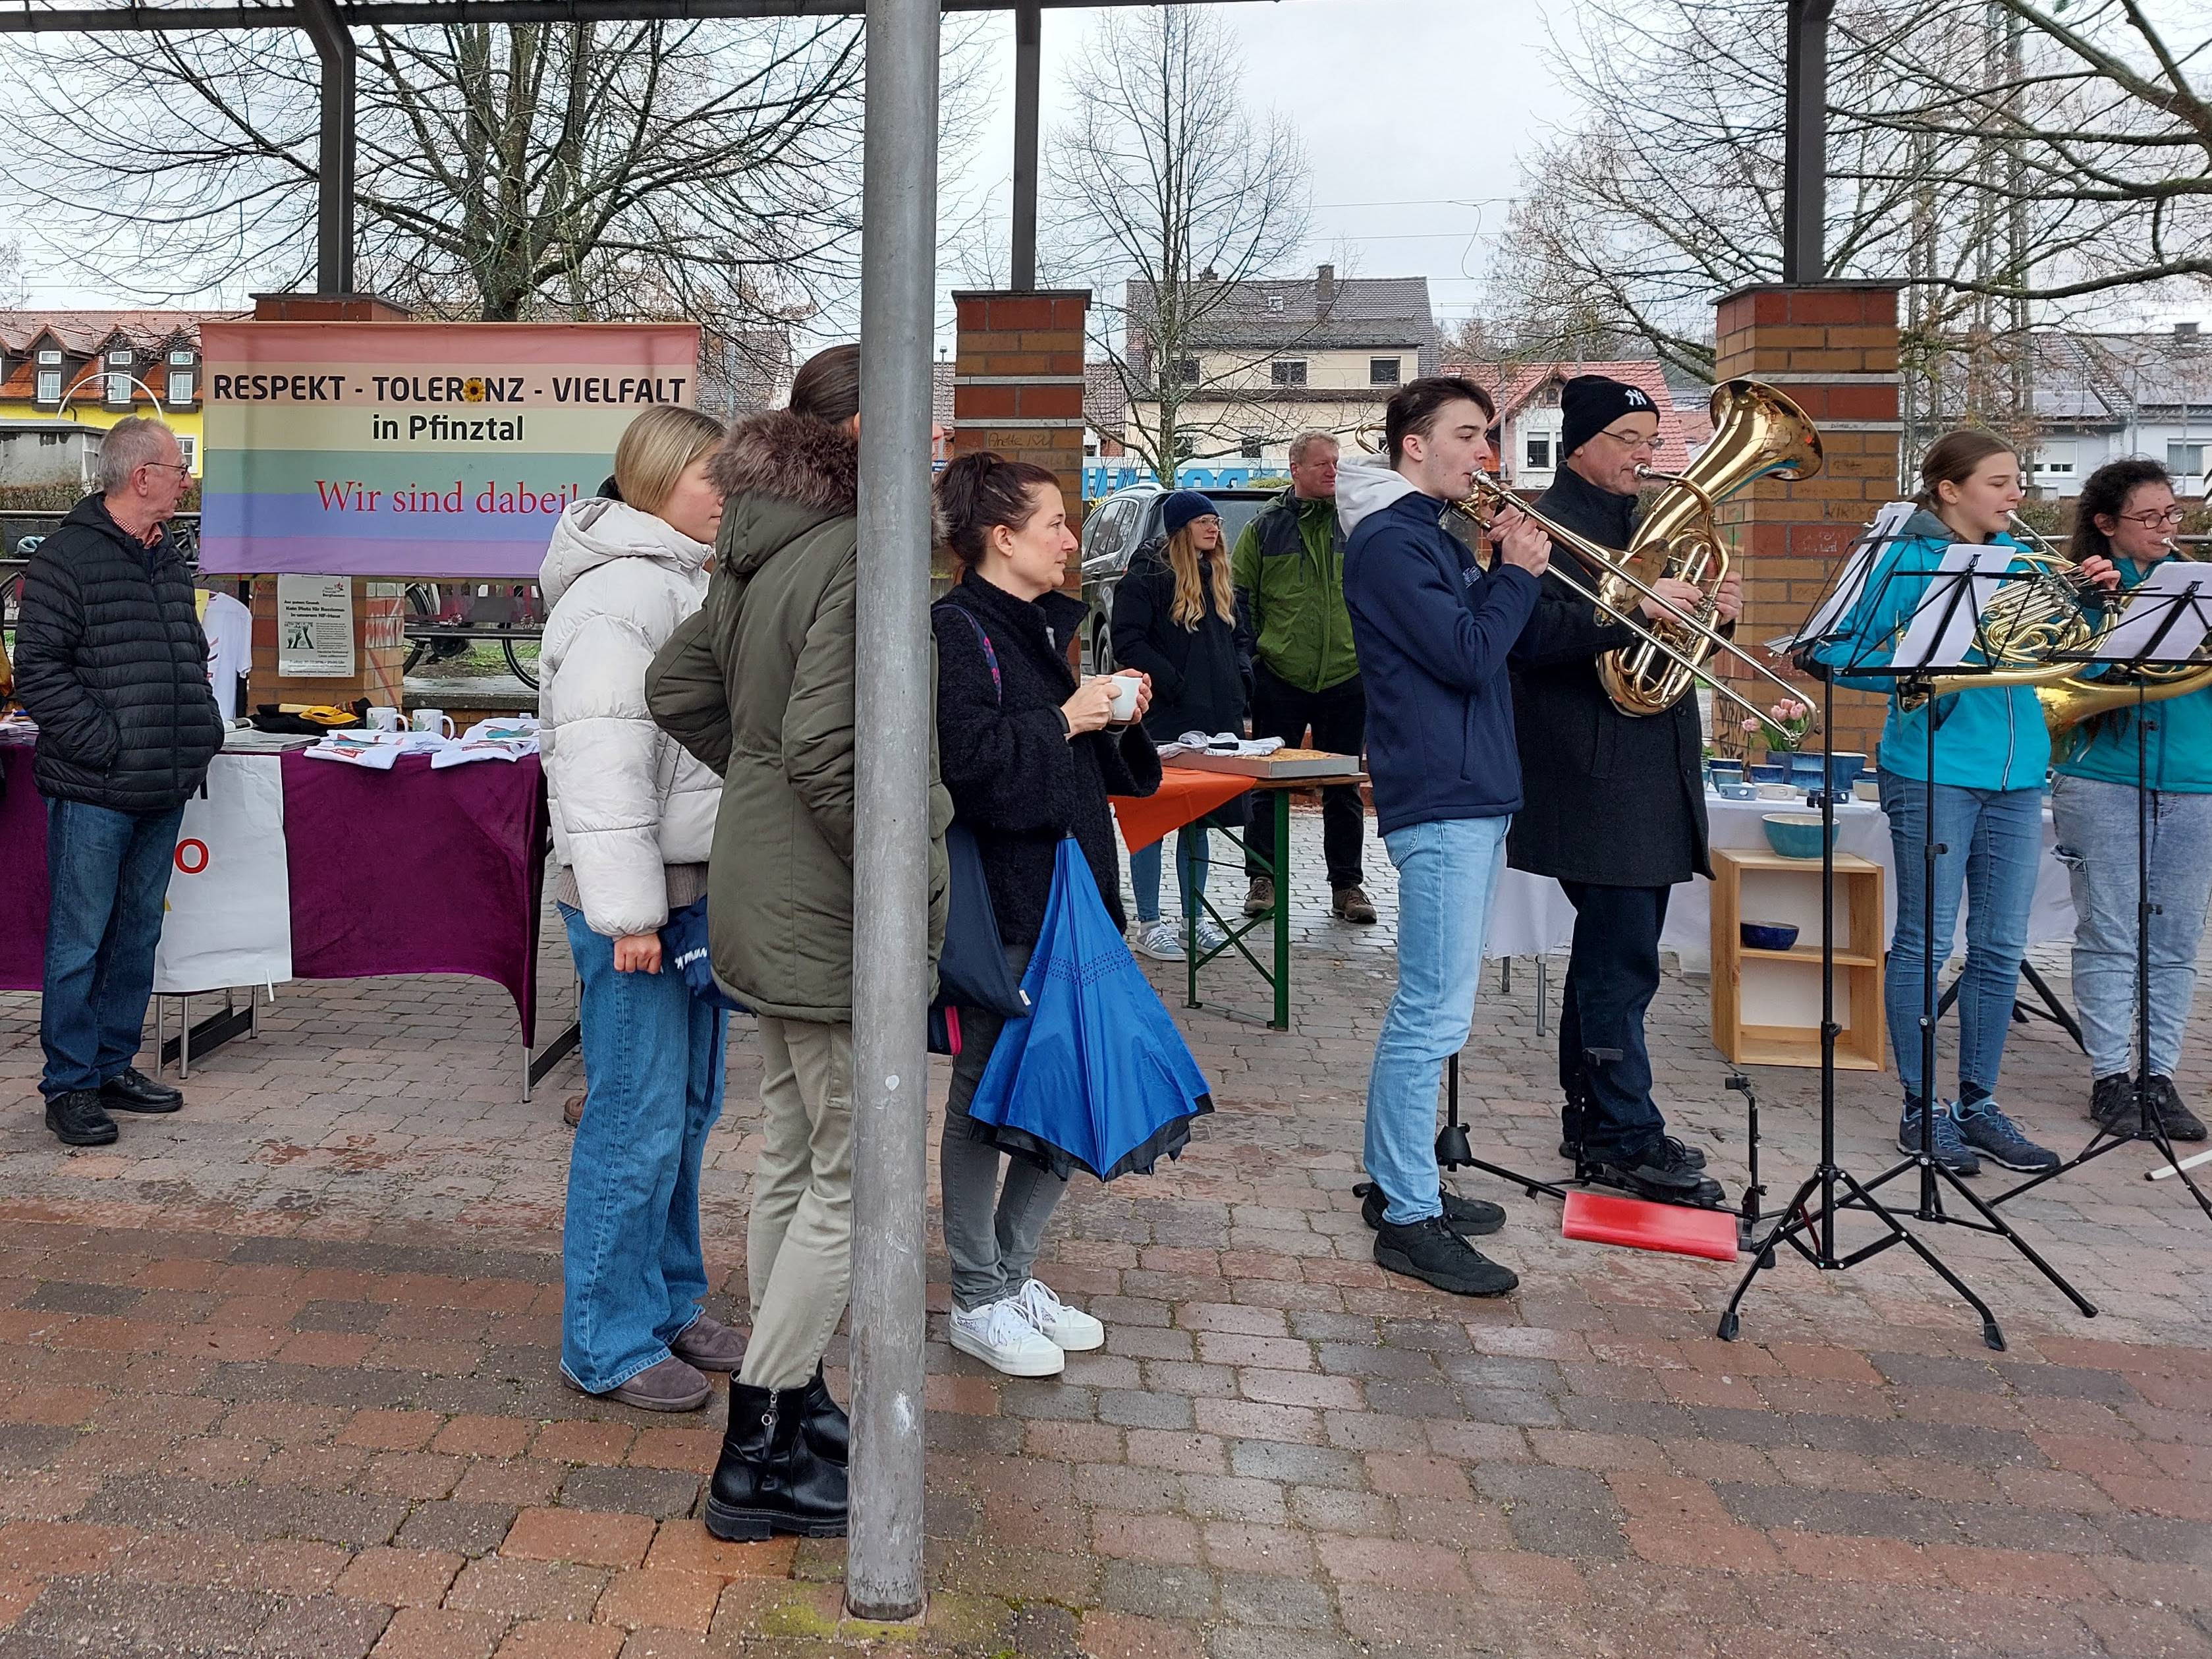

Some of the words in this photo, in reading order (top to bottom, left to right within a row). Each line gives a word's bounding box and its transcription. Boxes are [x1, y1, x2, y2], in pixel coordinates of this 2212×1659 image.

[213, 374, 346, 401] RESPEKT
[372, 376, 524, 403] TOLERNZ
[552, 377, 686, 403] VIELFALT
[373, 414, 399, 440] in
[409, 414, 523, 441] Pfinztal
[315, 480, 381, 512] Wir
[393, 480, 464, 513] sind
[476, 480, 578, 514] dabei!
